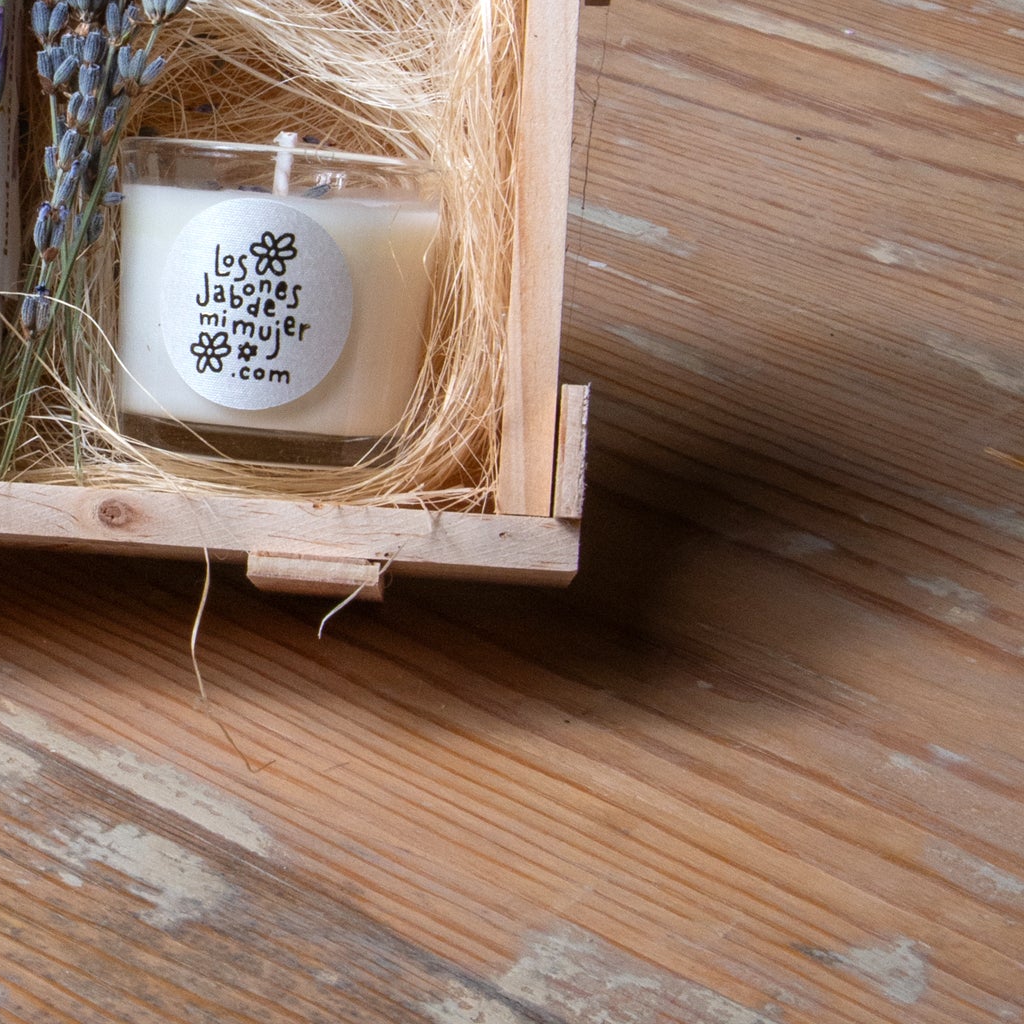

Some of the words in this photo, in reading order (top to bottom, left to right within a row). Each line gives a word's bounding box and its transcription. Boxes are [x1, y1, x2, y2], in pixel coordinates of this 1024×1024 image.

[215, 244, 248, 282] Los
[196, 272, 302, 309] Jabones
[247, 297, 275, 317] de
[200, 310, 227, 327] mi
[232, 316, 311, 360] mujer
[231, 366, 290, 384] .com
